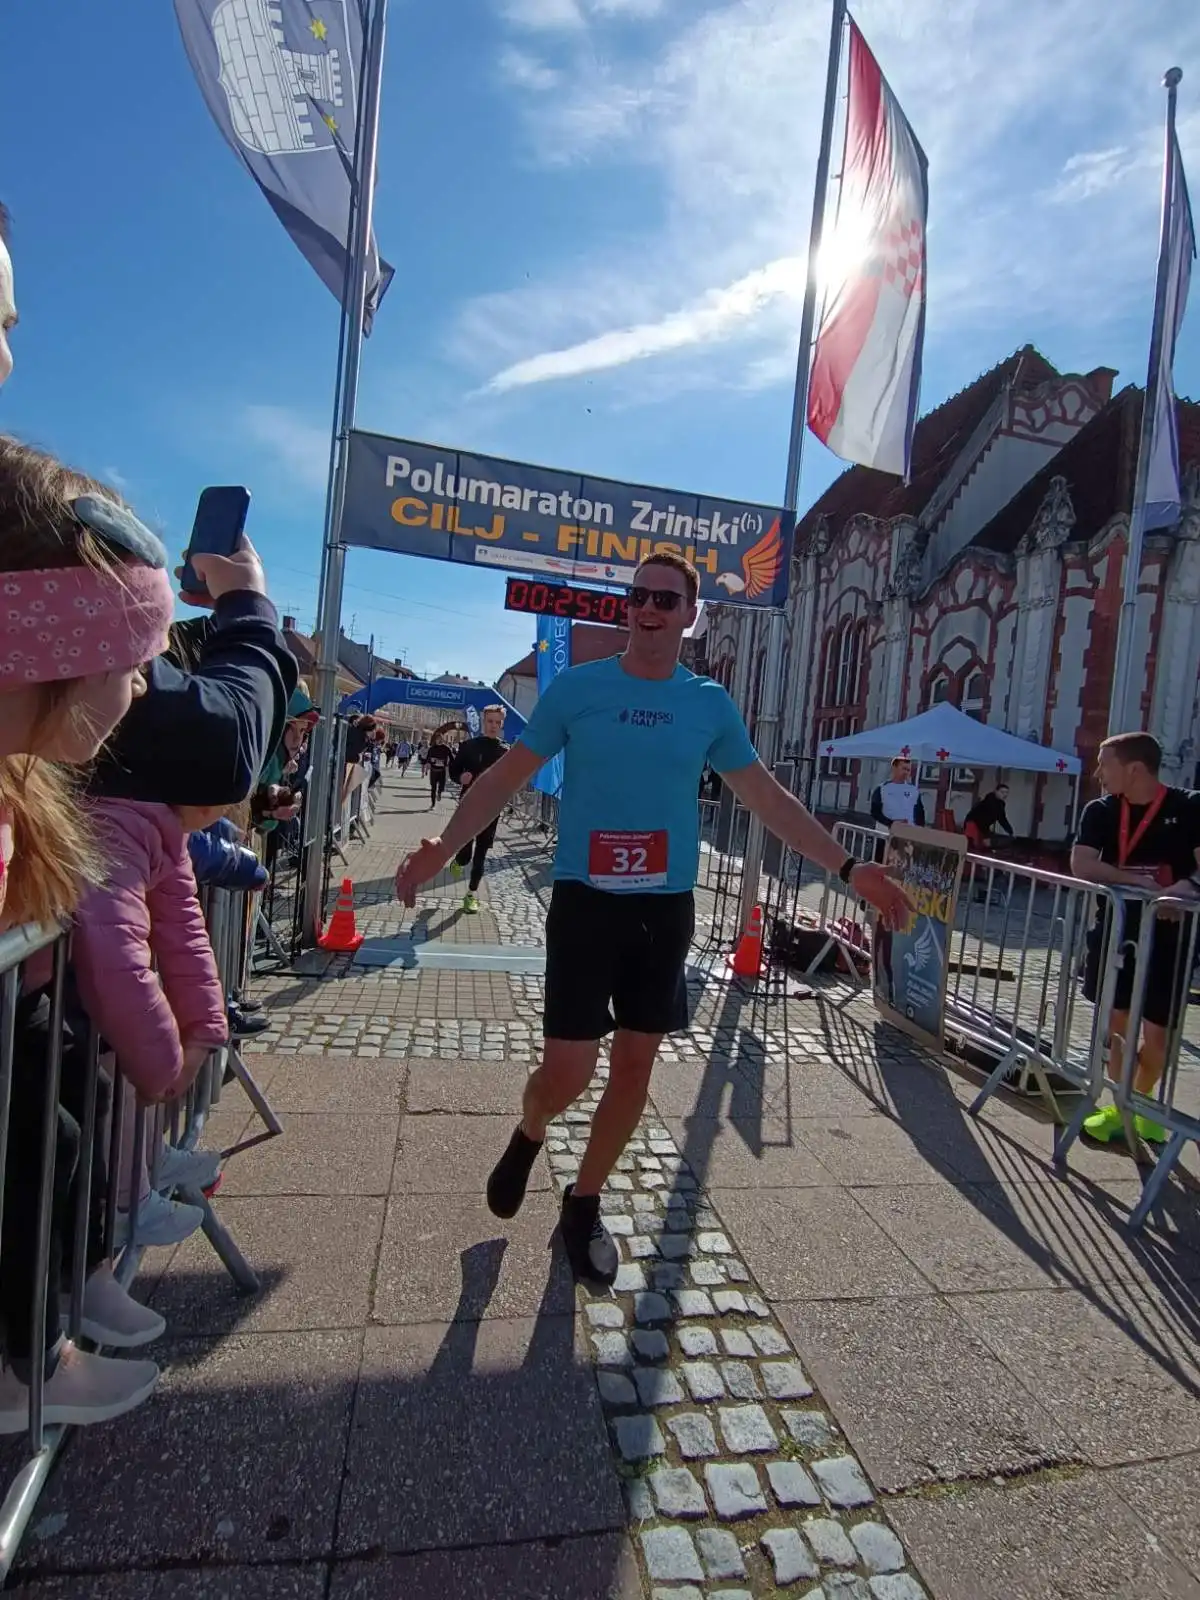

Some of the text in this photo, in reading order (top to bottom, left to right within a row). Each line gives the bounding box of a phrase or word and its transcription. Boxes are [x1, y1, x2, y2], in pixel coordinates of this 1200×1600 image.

[385, 455, 614, 525] Polumaraton
[391, 496, 505, 540] CILJ
[522, 532, 540, 542] -
[410, 687, 462, 700] DECATHLON
[631, 709, 674, 720] ZRINSKI
[612, 847, 648, 873] 32
